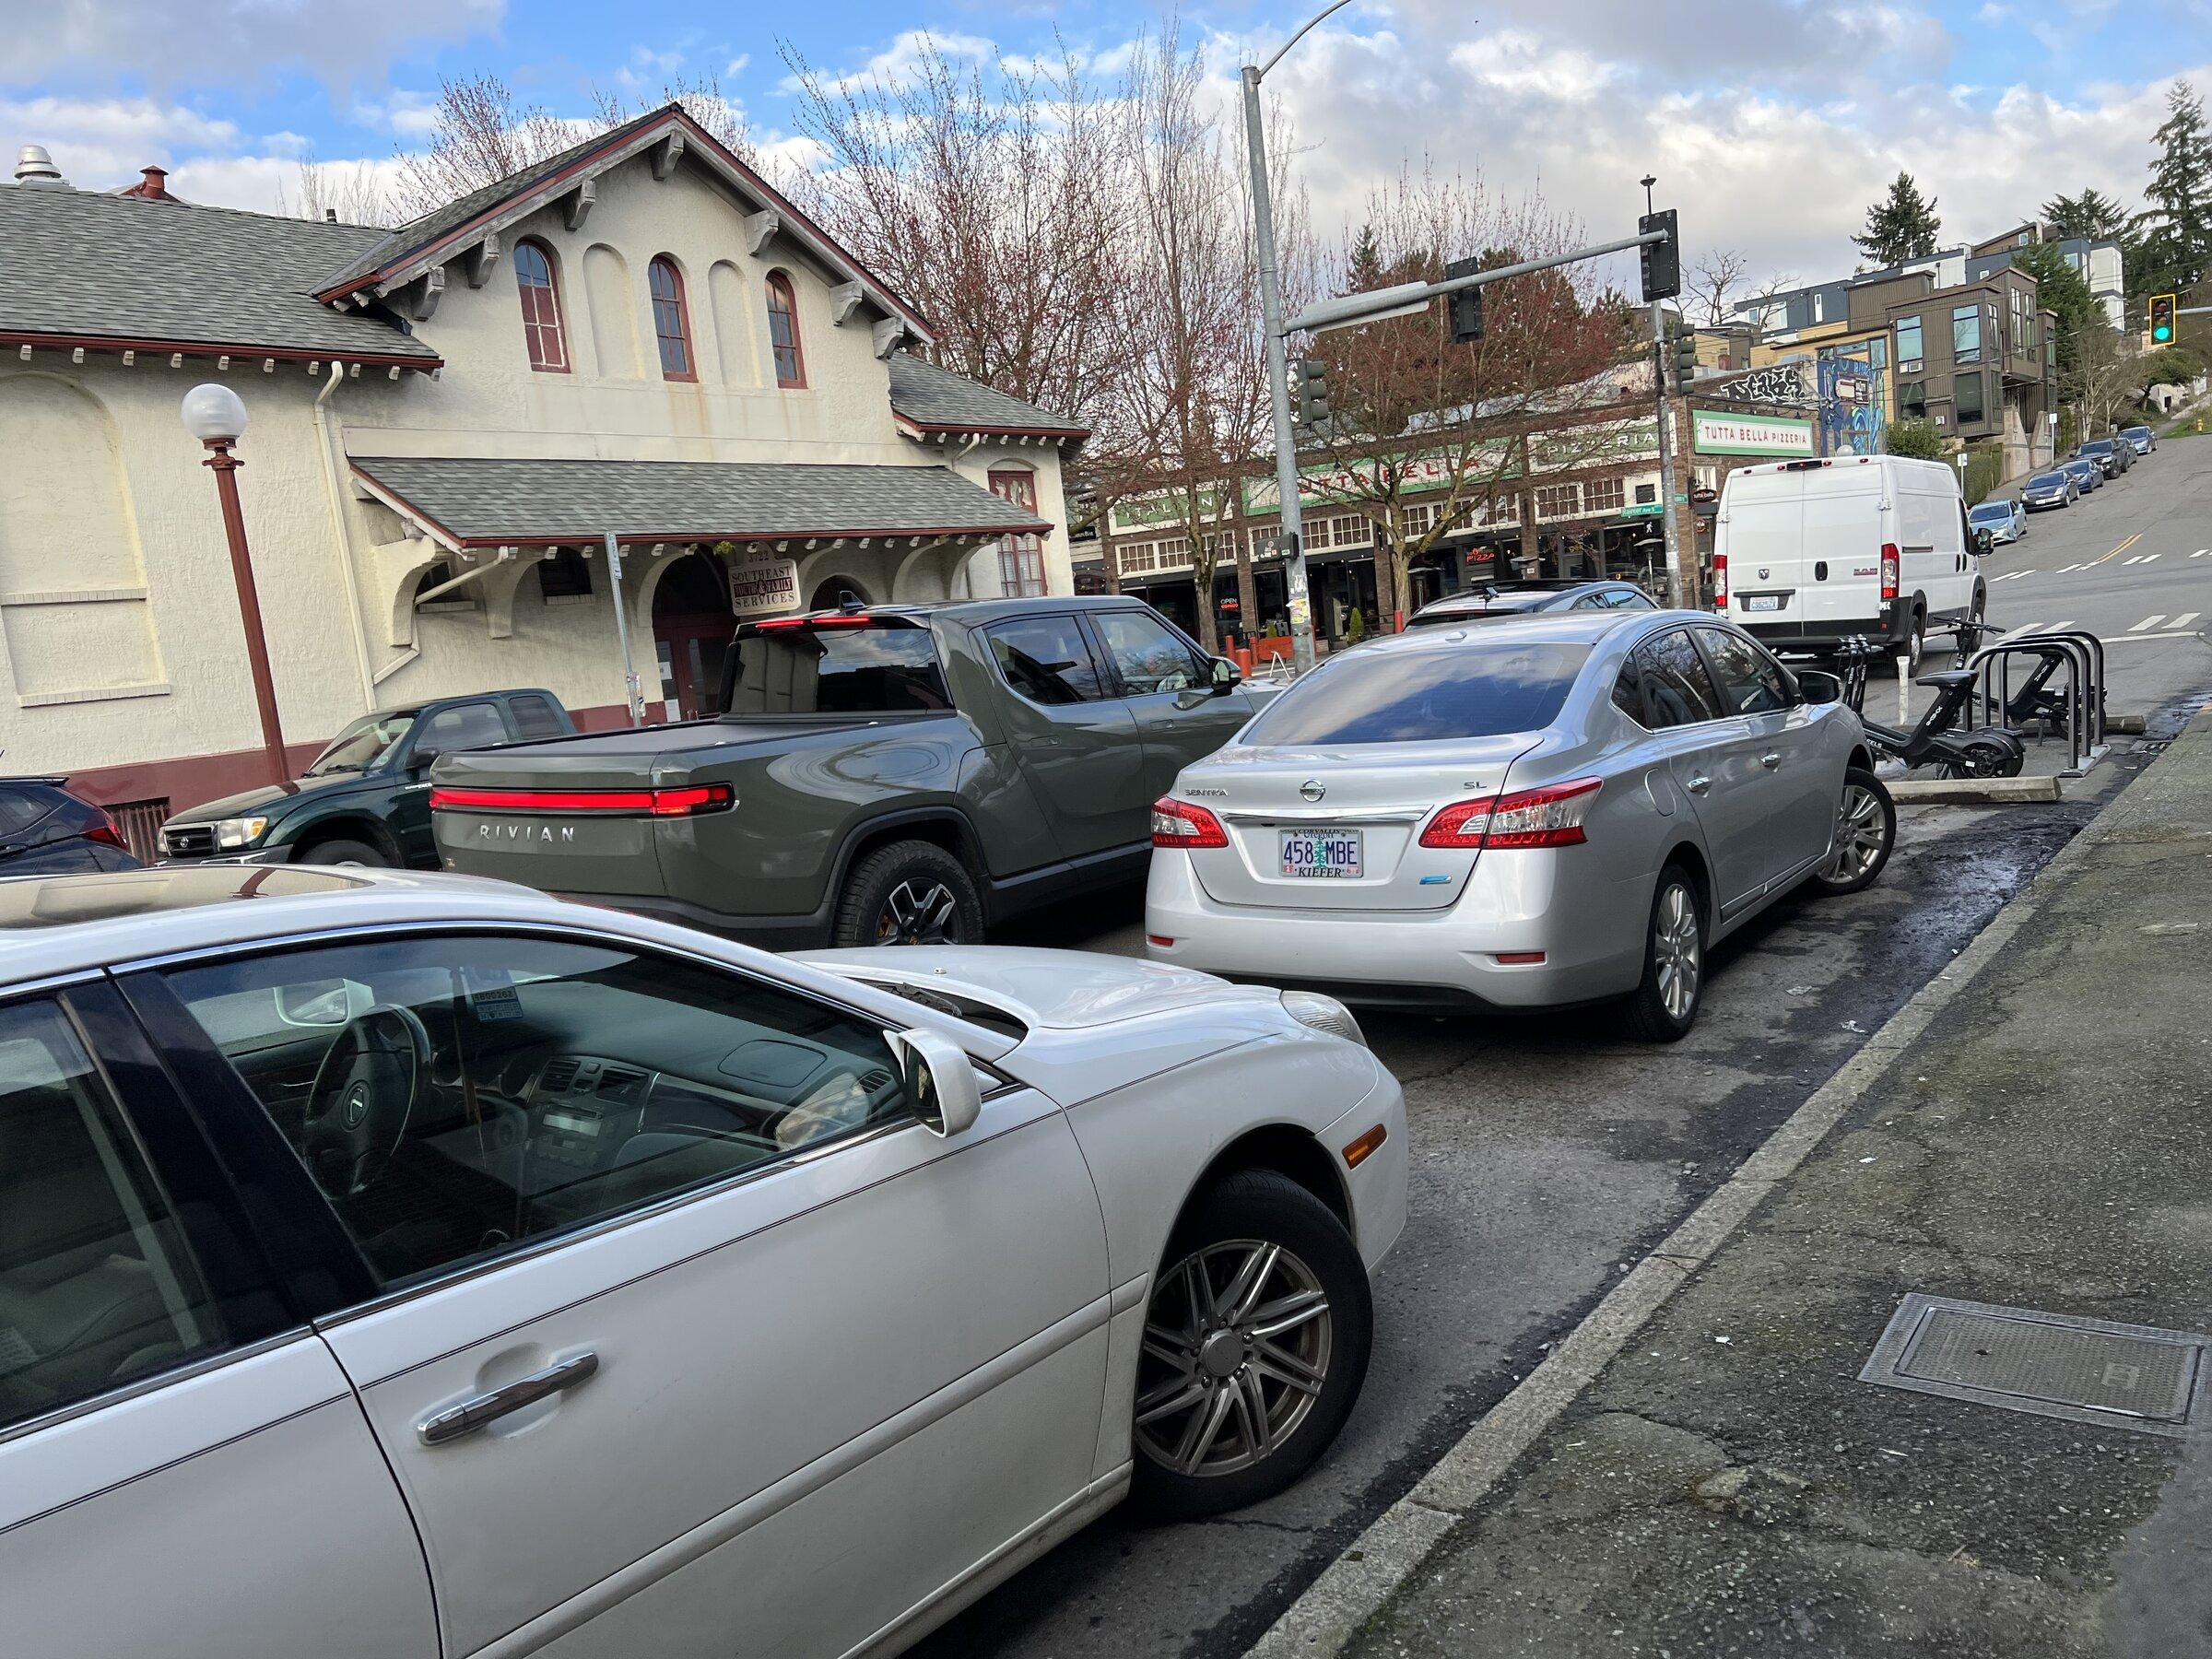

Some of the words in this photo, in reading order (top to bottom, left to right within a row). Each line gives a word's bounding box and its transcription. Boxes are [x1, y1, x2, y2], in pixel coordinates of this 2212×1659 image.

[1705, 426, 1735, 440] TUTTA
[1740, 429, 1769, 441] BELLA
[1772, 432, 1806, 443] PIZZERIA
[1298, 473, 1370, 494] UTTA
[1125, 496, 1214, 519] ITALN
[1466, 552, 1494, 562] PIZZA
[732, 566, 791, 582] SOUTHEAST
[767, 578, 792, 592] FAMILY
[735, 592, 795, 608] SERVICES
[1463, 782, 1488, 790] SL
[479, 824, 575, 842] RIVIAN
[1284, 841, 1314, 865] 458
[1325, 841, 1358, 865] MBE
[1298, 865, 1342, 878] KIEFER
